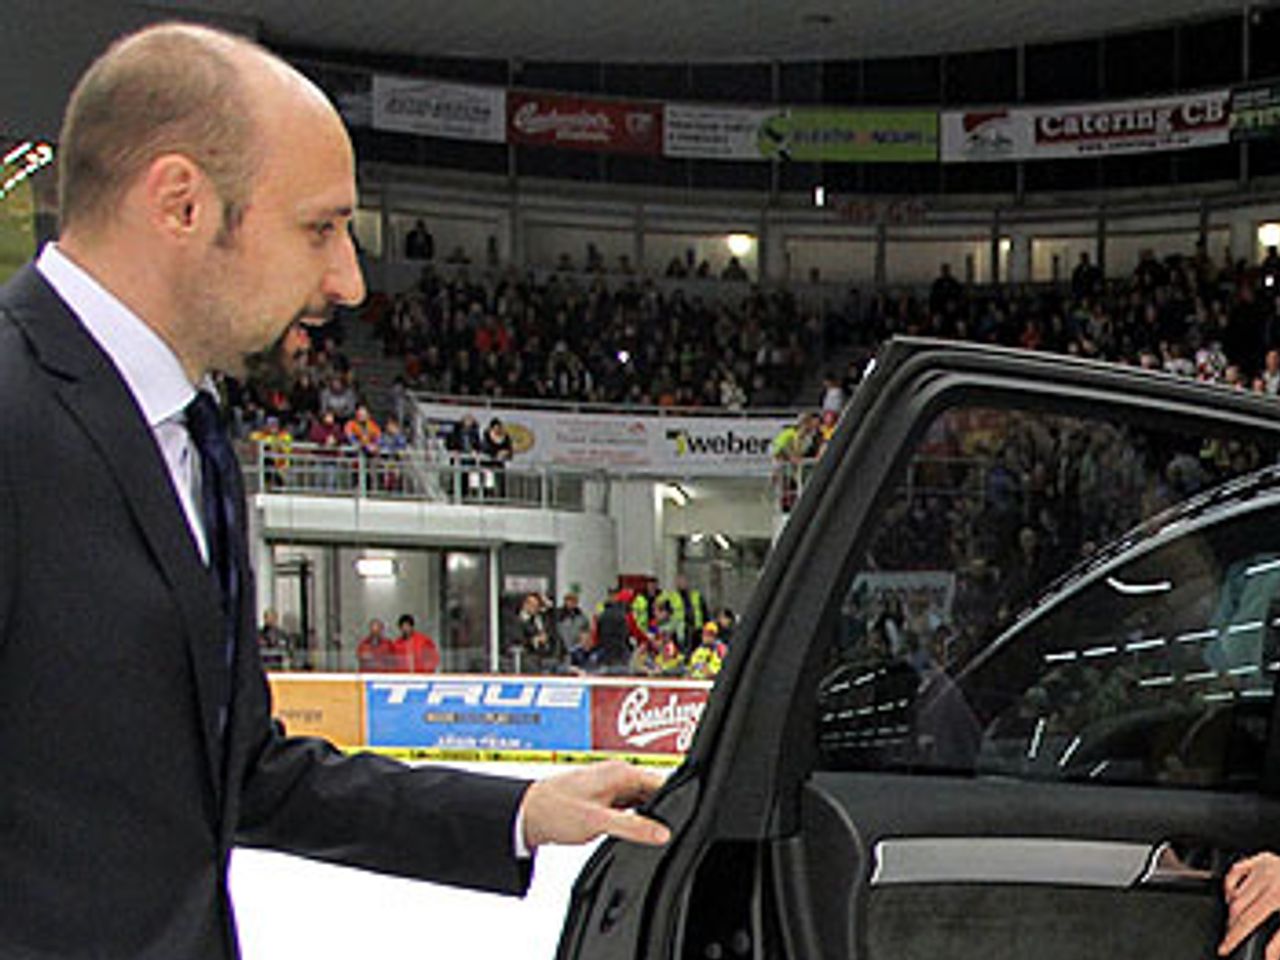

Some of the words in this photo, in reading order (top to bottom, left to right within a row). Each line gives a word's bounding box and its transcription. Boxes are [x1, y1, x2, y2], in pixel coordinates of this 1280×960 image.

[1040, 108, 1173, 137] Catering
[1181, 98, 1225, 124] CB
[686, 430, 772, 456] weber
[371, 682, 590, 708] TRUE
